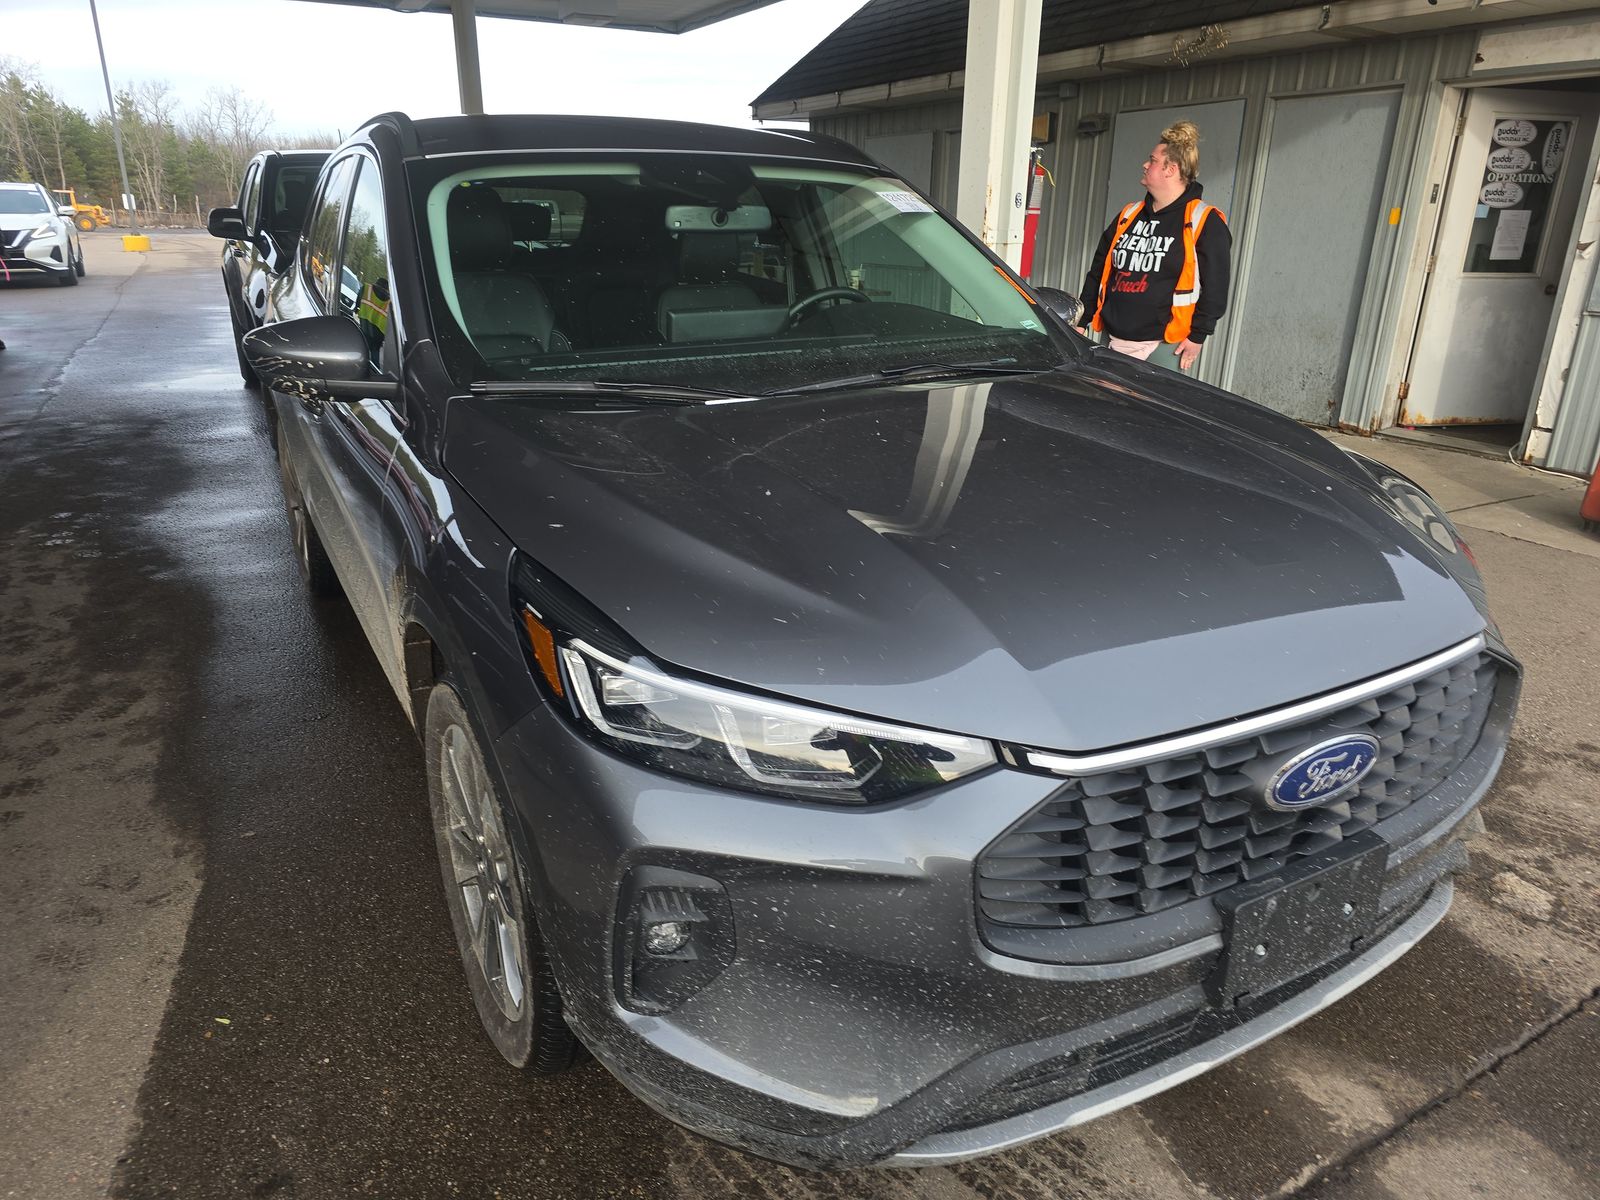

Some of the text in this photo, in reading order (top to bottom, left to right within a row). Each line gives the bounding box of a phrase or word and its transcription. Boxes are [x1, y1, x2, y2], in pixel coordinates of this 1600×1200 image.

[1487, 173, 1554, 184] OPERATIONS
[1132, 220, 1160, 237] NOT
[1128, 251, 1166, 272] NOT
[1111, 271, 1149, 293] Touch
[1298, 751, 1362, 799] Ford
